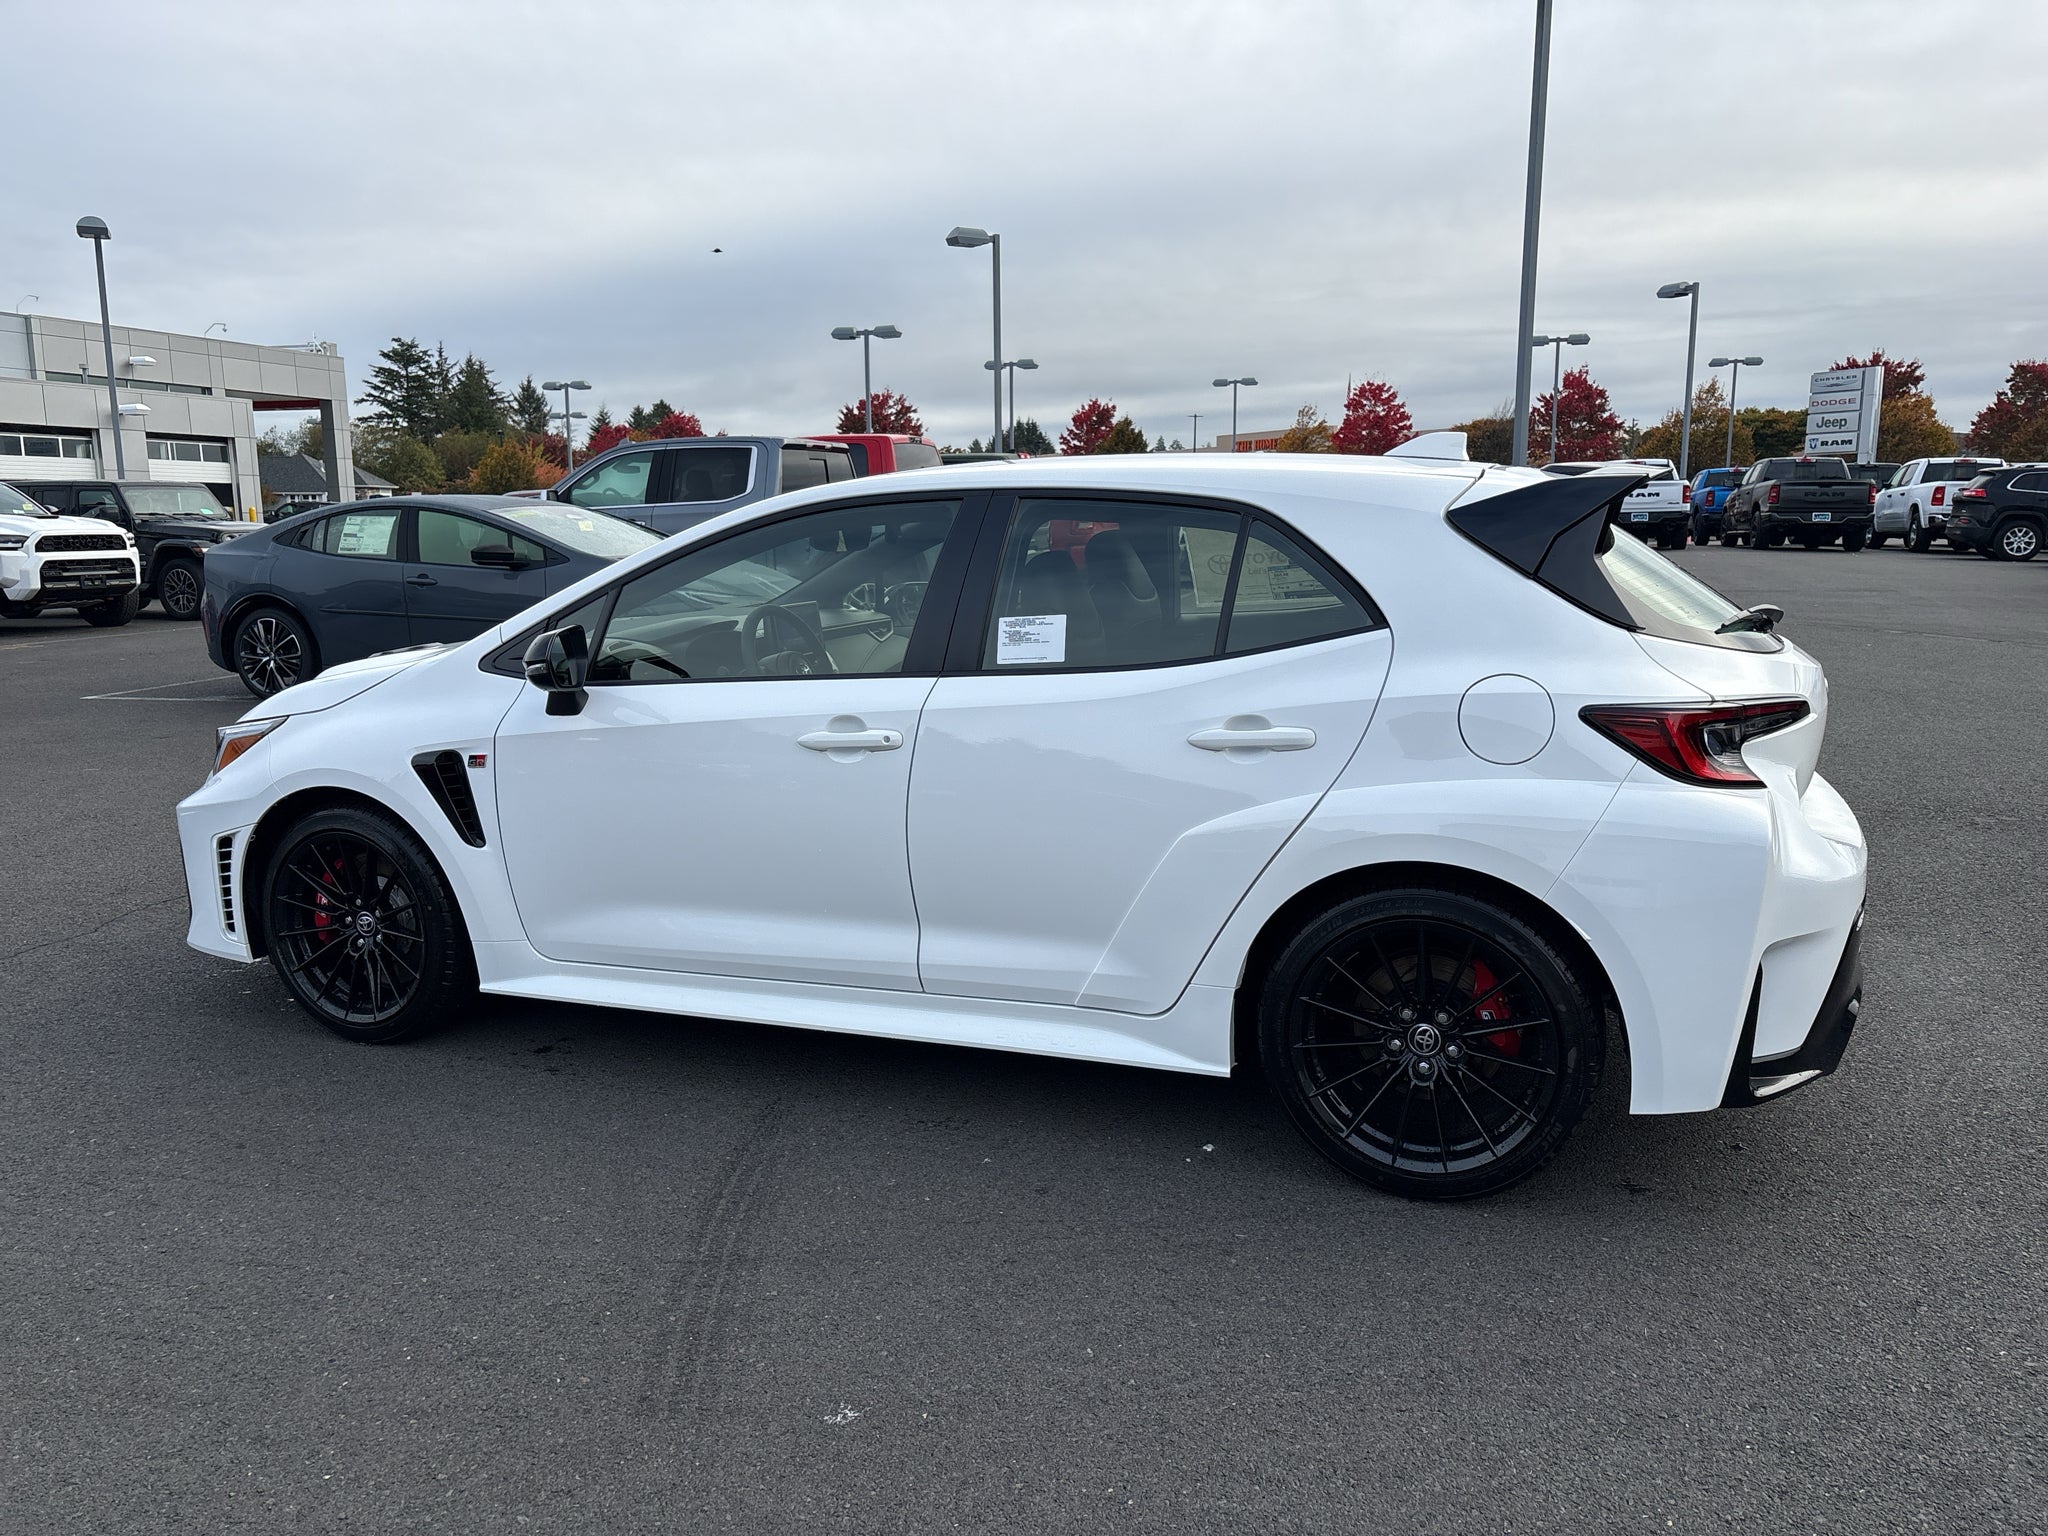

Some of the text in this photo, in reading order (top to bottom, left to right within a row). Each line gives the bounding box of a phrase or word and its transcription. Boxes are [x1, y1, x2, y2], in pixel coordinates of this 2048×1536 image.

[1814, 375, 1857, 383] CHRYSLER
[1811, 398, 1857, 408] DODGE
[1816, 416, 1848, 429] Jeep
[1820, 439, 1853, 447] RAM
